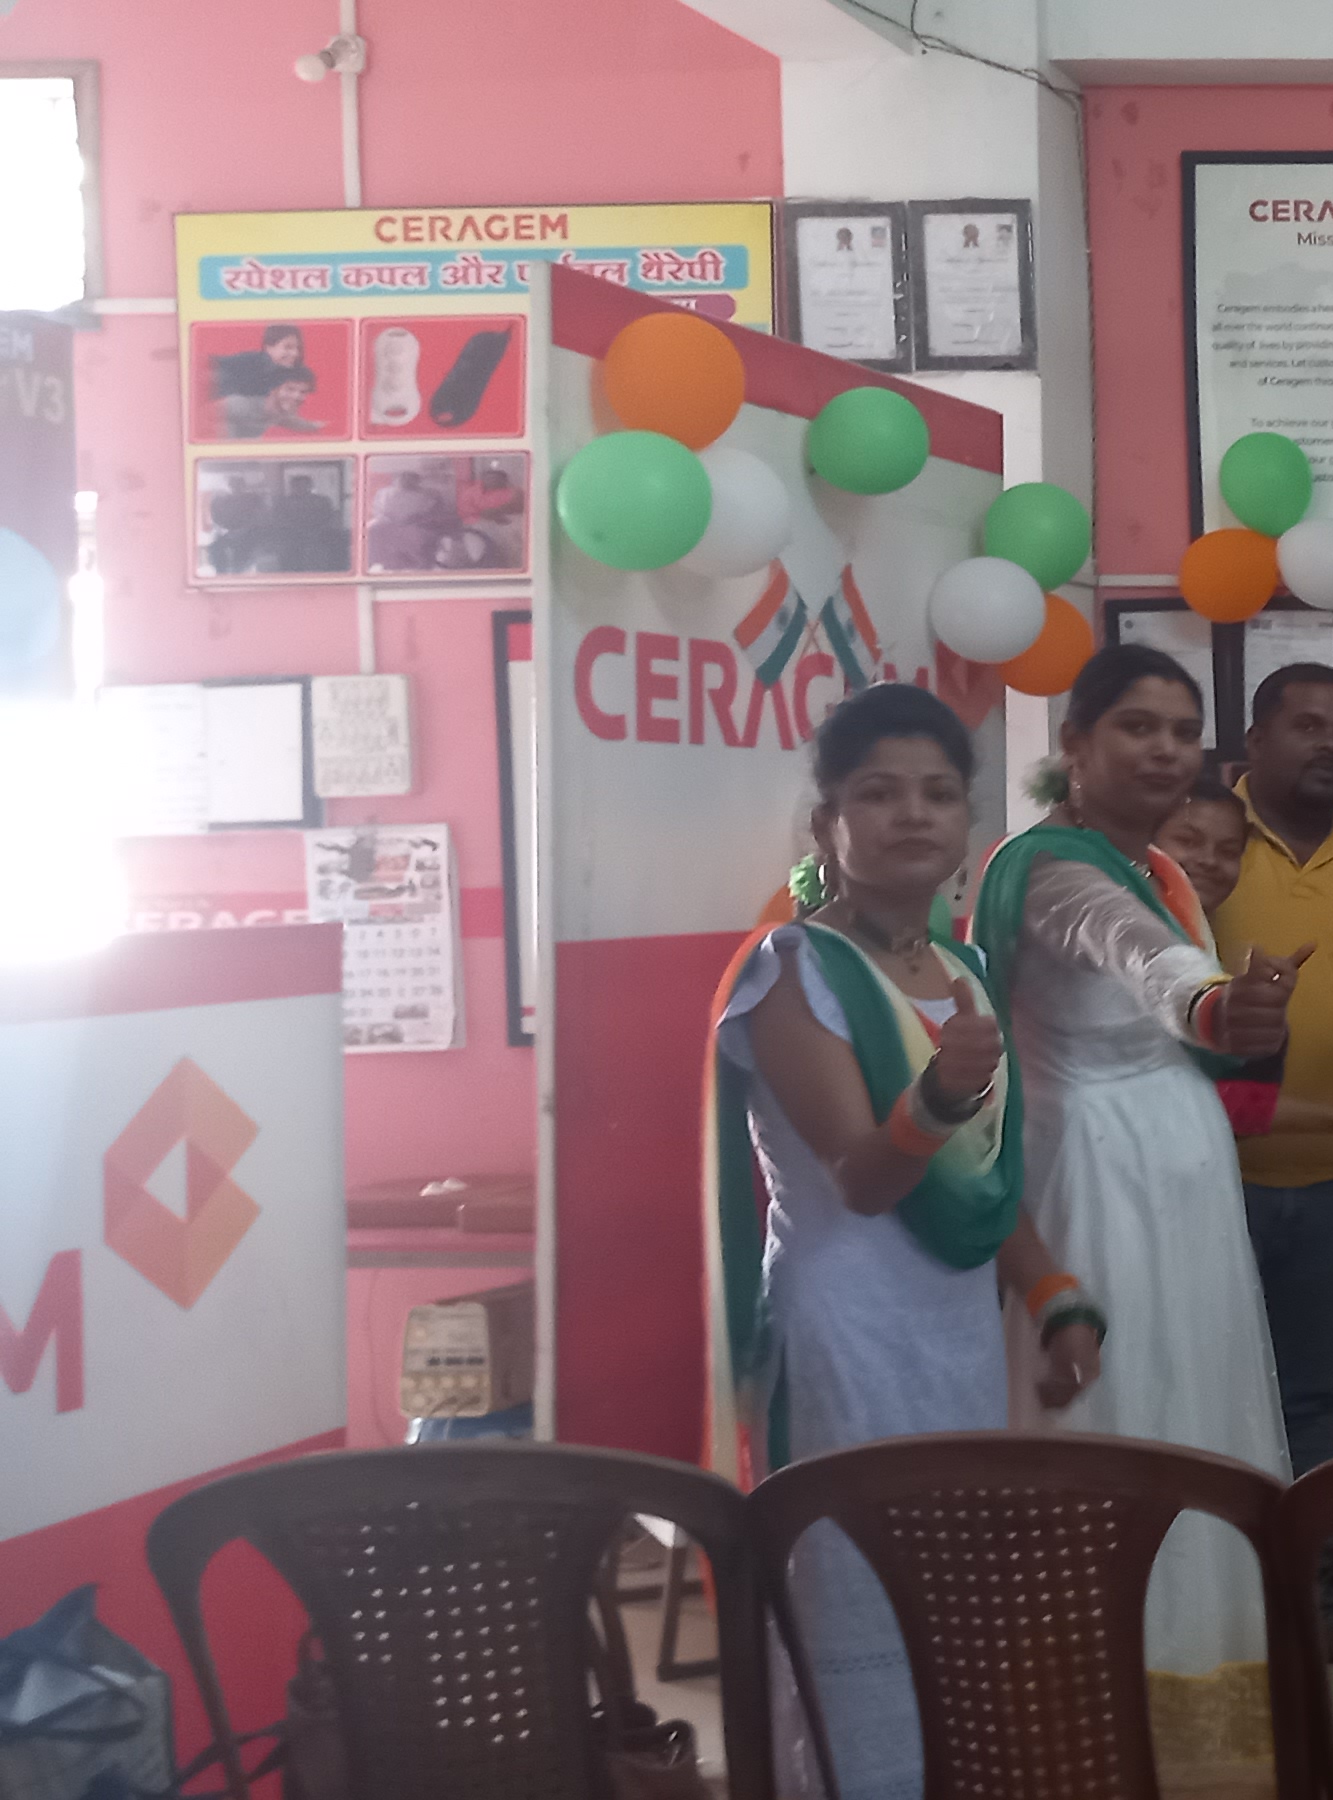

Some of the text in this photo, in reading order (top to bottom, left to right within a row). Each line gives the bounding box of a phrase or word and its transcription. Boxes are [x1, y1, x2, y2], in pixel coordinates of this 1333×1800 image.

[373, 213, 570, 245] CERAGEM
[221, 254, 331, 294] स्पेशल
[340, 259, 431, 292] कपल
[440, 250, 507, 290] और
